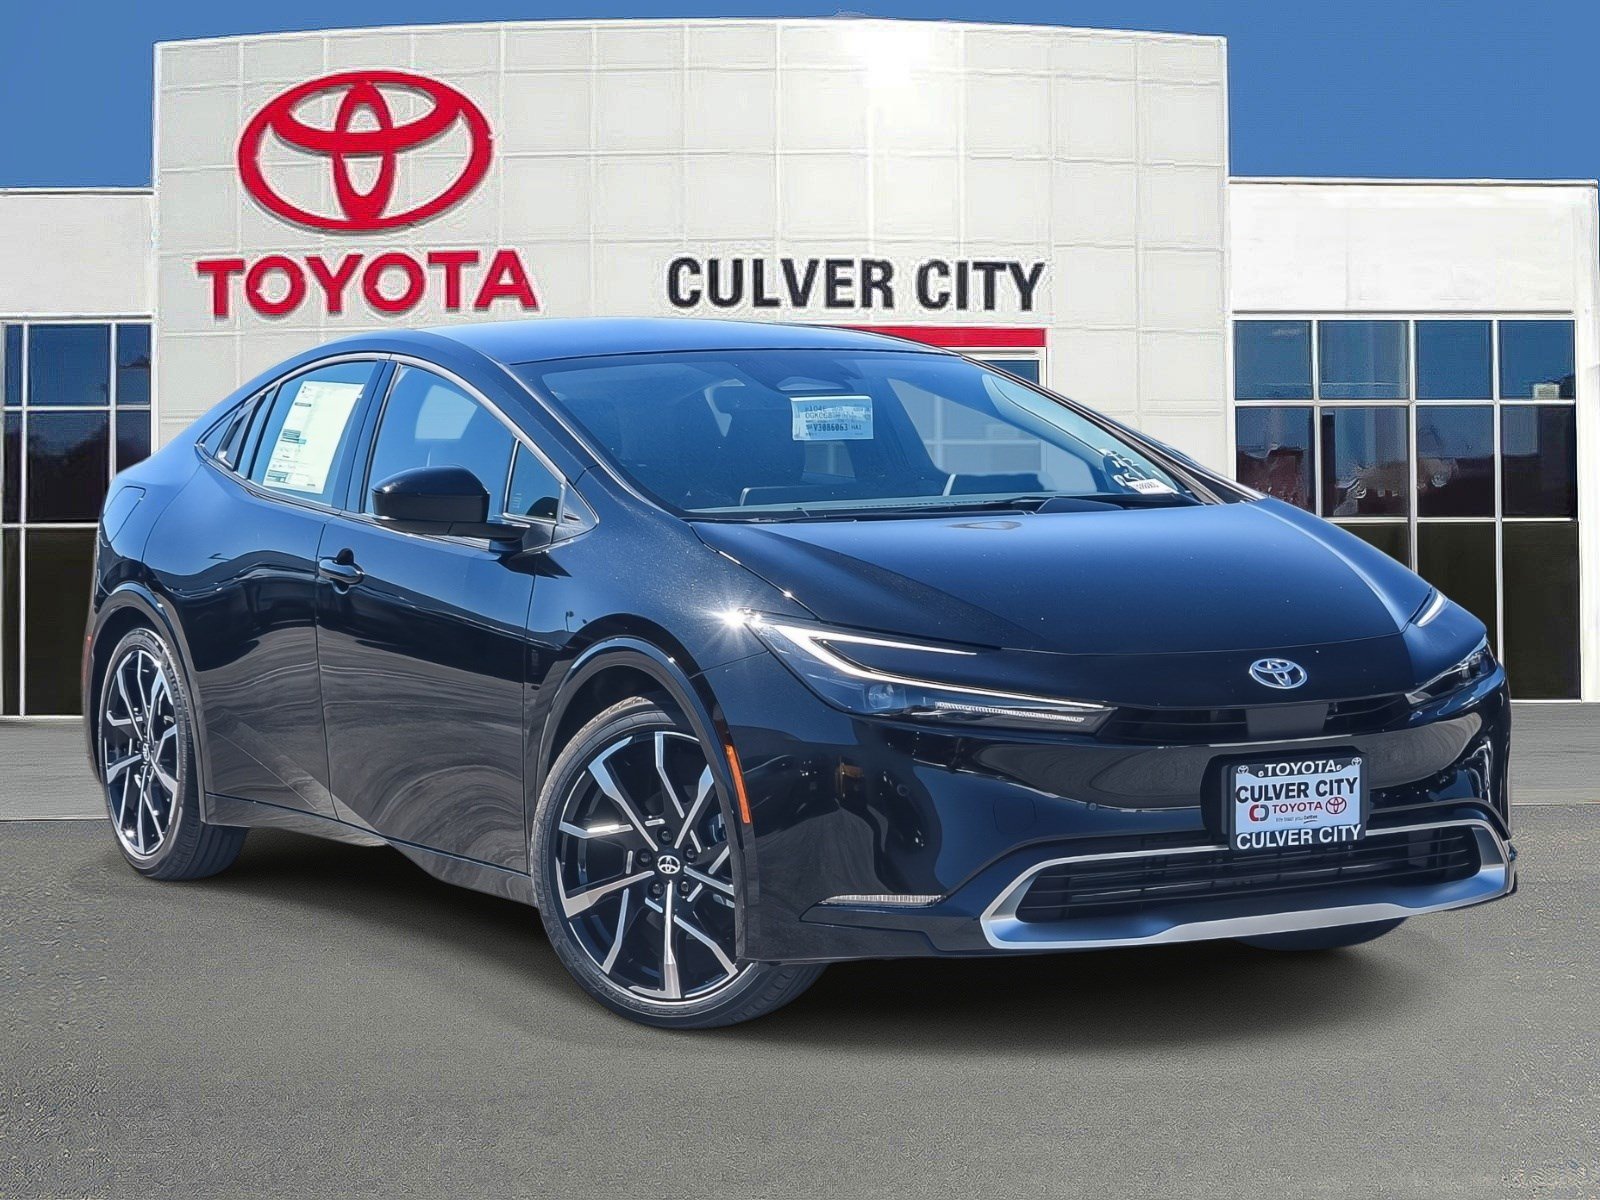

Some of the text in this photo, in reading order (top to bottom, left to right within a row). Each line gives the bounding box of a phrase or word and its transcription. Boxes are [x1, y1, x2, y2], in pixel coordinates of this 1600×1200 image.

[196, 249, 539, 319] TOYOTA
[667, 257, 1045, 311] CULVER CITY
[1265, 760, 1336, 776] TOYOTA
[1235, 777, 1358, 803] CULVER CITY
[1272, 802, 1323, 814] TOYOTA
[1236, 824, 1361, 850] CULVER CITY
